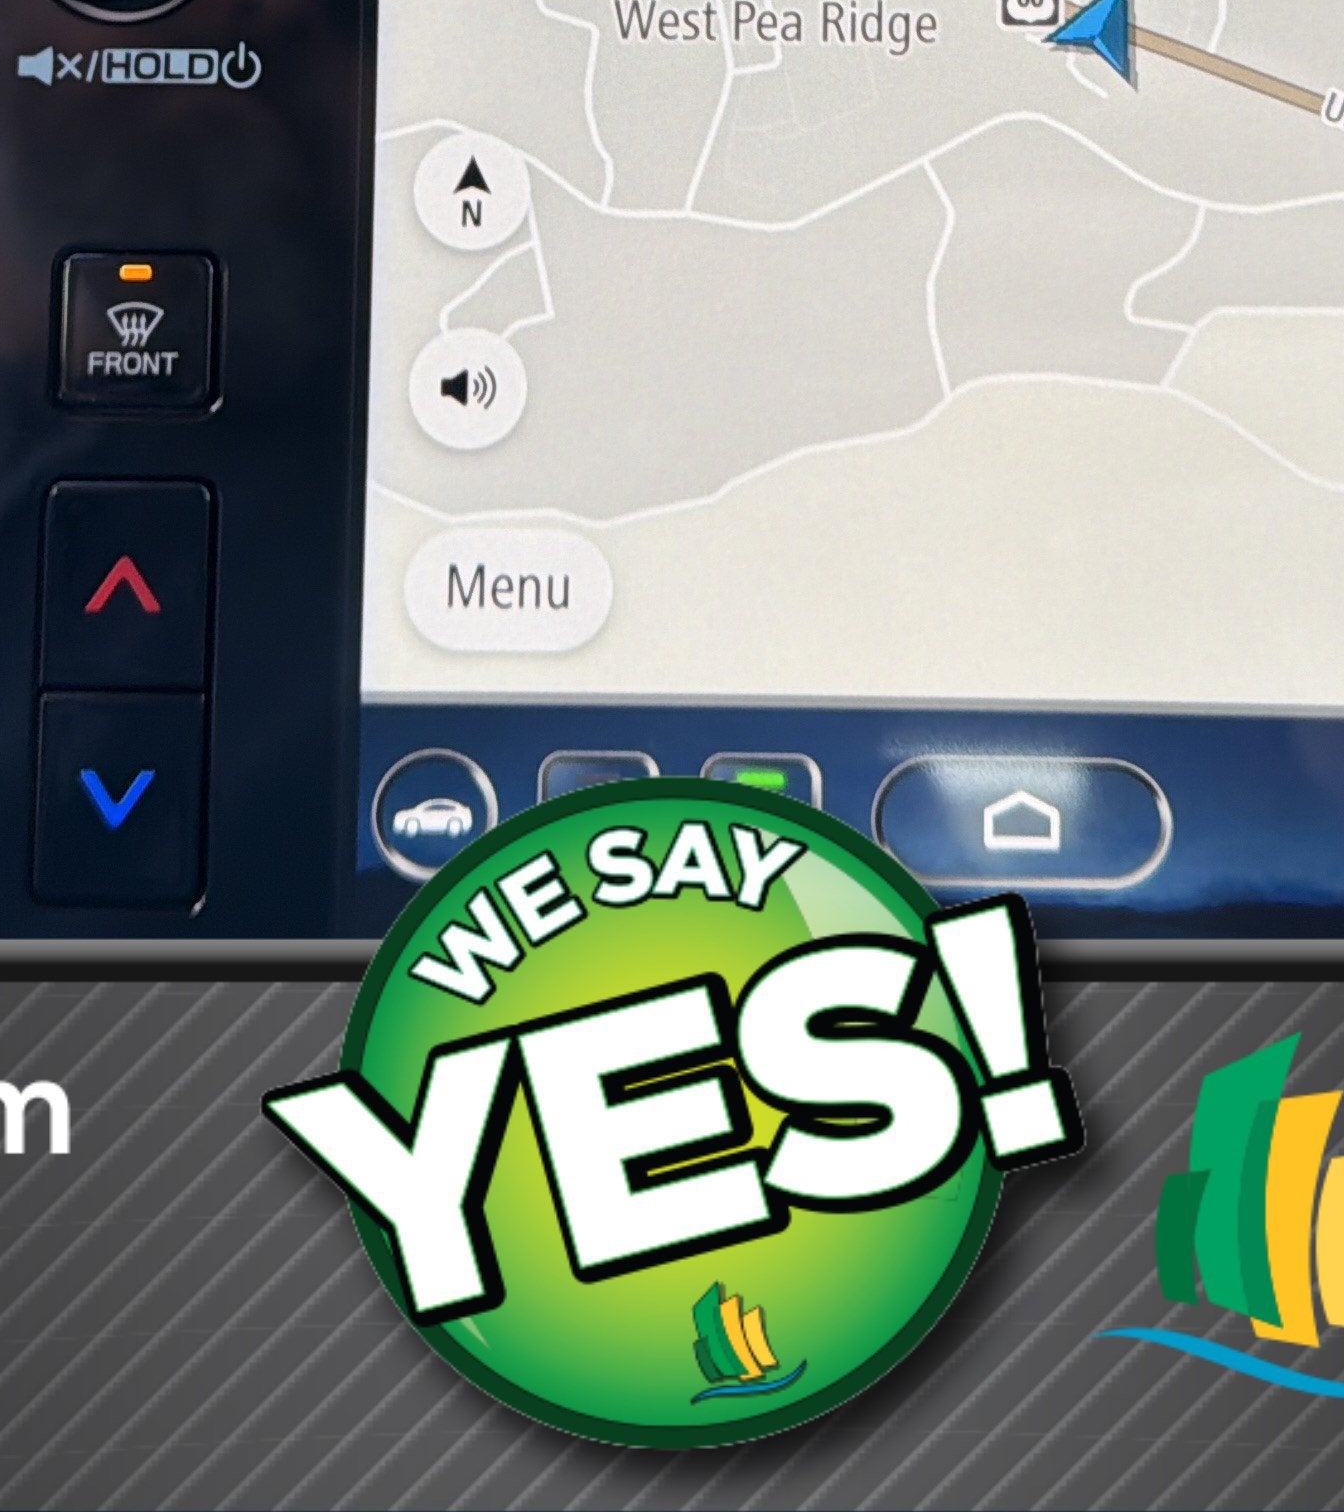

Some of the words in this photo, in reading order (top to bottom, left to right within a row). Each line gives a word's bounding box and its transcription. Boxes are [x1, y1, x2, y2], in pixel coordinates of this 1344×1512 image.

[613, 0, 717, 43] West
[733, 0, 804, 43] Pea
[821, 0, 939, 55] Ridge
[460, 199, 484, 229] N
[87, 351, 179, 376] FRONT
[446, 563, 571, 610] Menu
